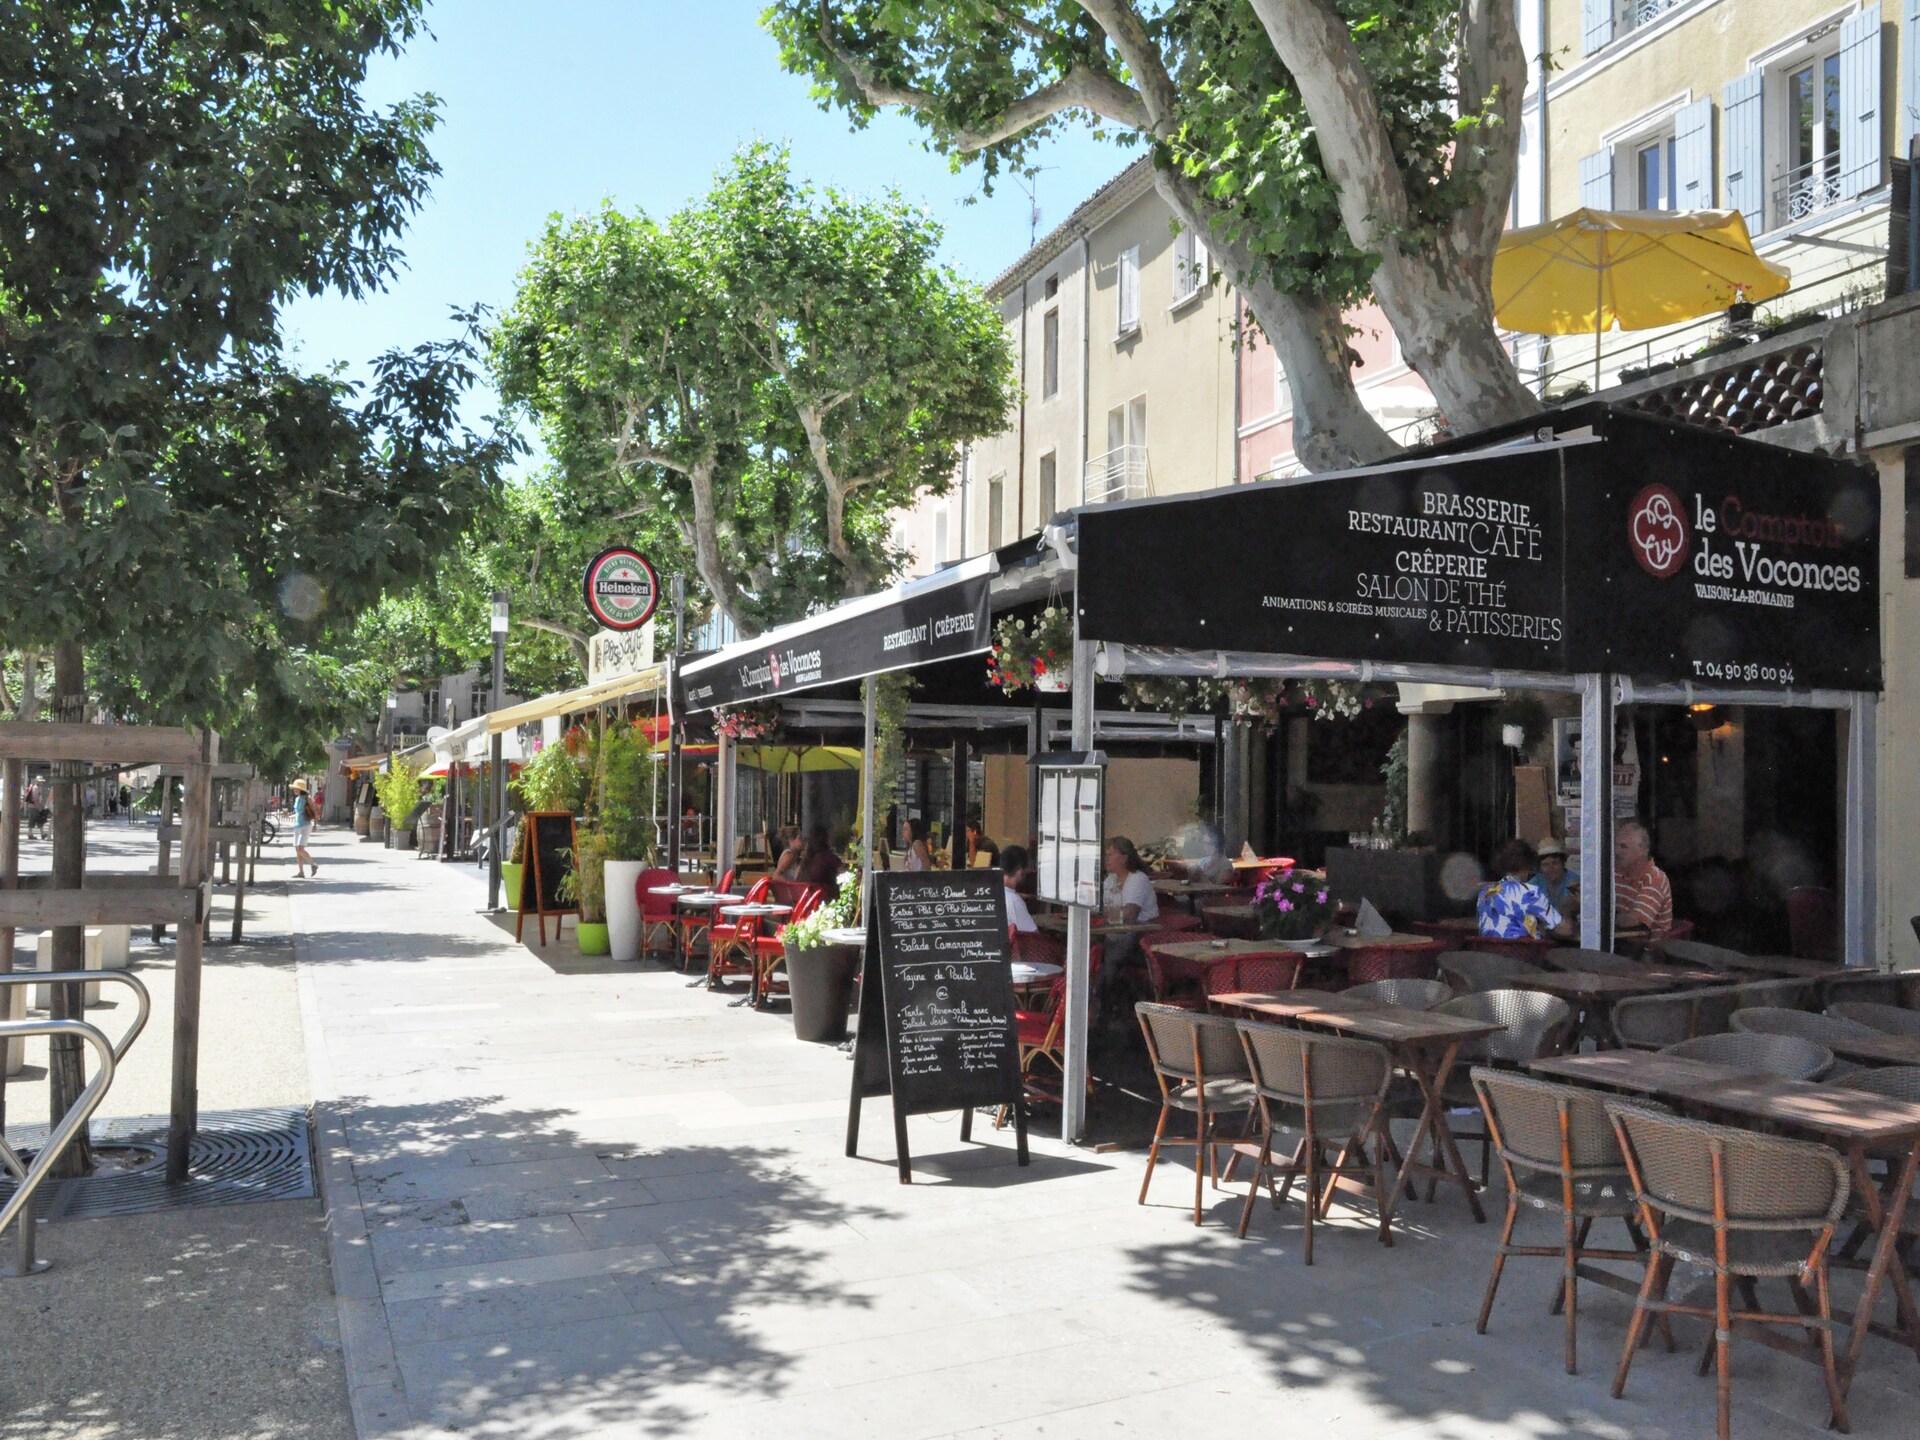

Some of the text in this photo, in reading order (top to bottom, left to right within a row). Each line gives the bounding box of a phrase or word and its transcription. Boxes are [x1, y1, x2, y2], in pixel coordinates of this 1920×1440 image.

[1423, 491, 1530, 527] BRASSERIE
[1695, 493, 1716, 532] le
[1348, 511, 1542, 561] RESTAURANT CAFÉ
[1396, 548, 1487, 578] CRÊPERIE
[1694, 538, 1860, 592] des Voconces
[599, 582, 649, 595] Heineken
[1357, 573, 1507, 608] SALON DE THÉ
[1695, 583, 1794, 608] VAISON-LA-ROMAINE
[1262, 595, 1427, 620] ANIMATIONS & SOIRÉES MUSICALES
[883, 612, 975, 651] RESTAURANT CRÊPERIE
[1429, 606, 1562, 641] & PÂTISSERIES
[1693, 660, 1794, 684] T. 04 90 36 00 94
[900, 938, 930, 952] Salade
[900, 965, 976, 990] Tajine de Poulet
[902, 1018, 927, 1030] Salade
